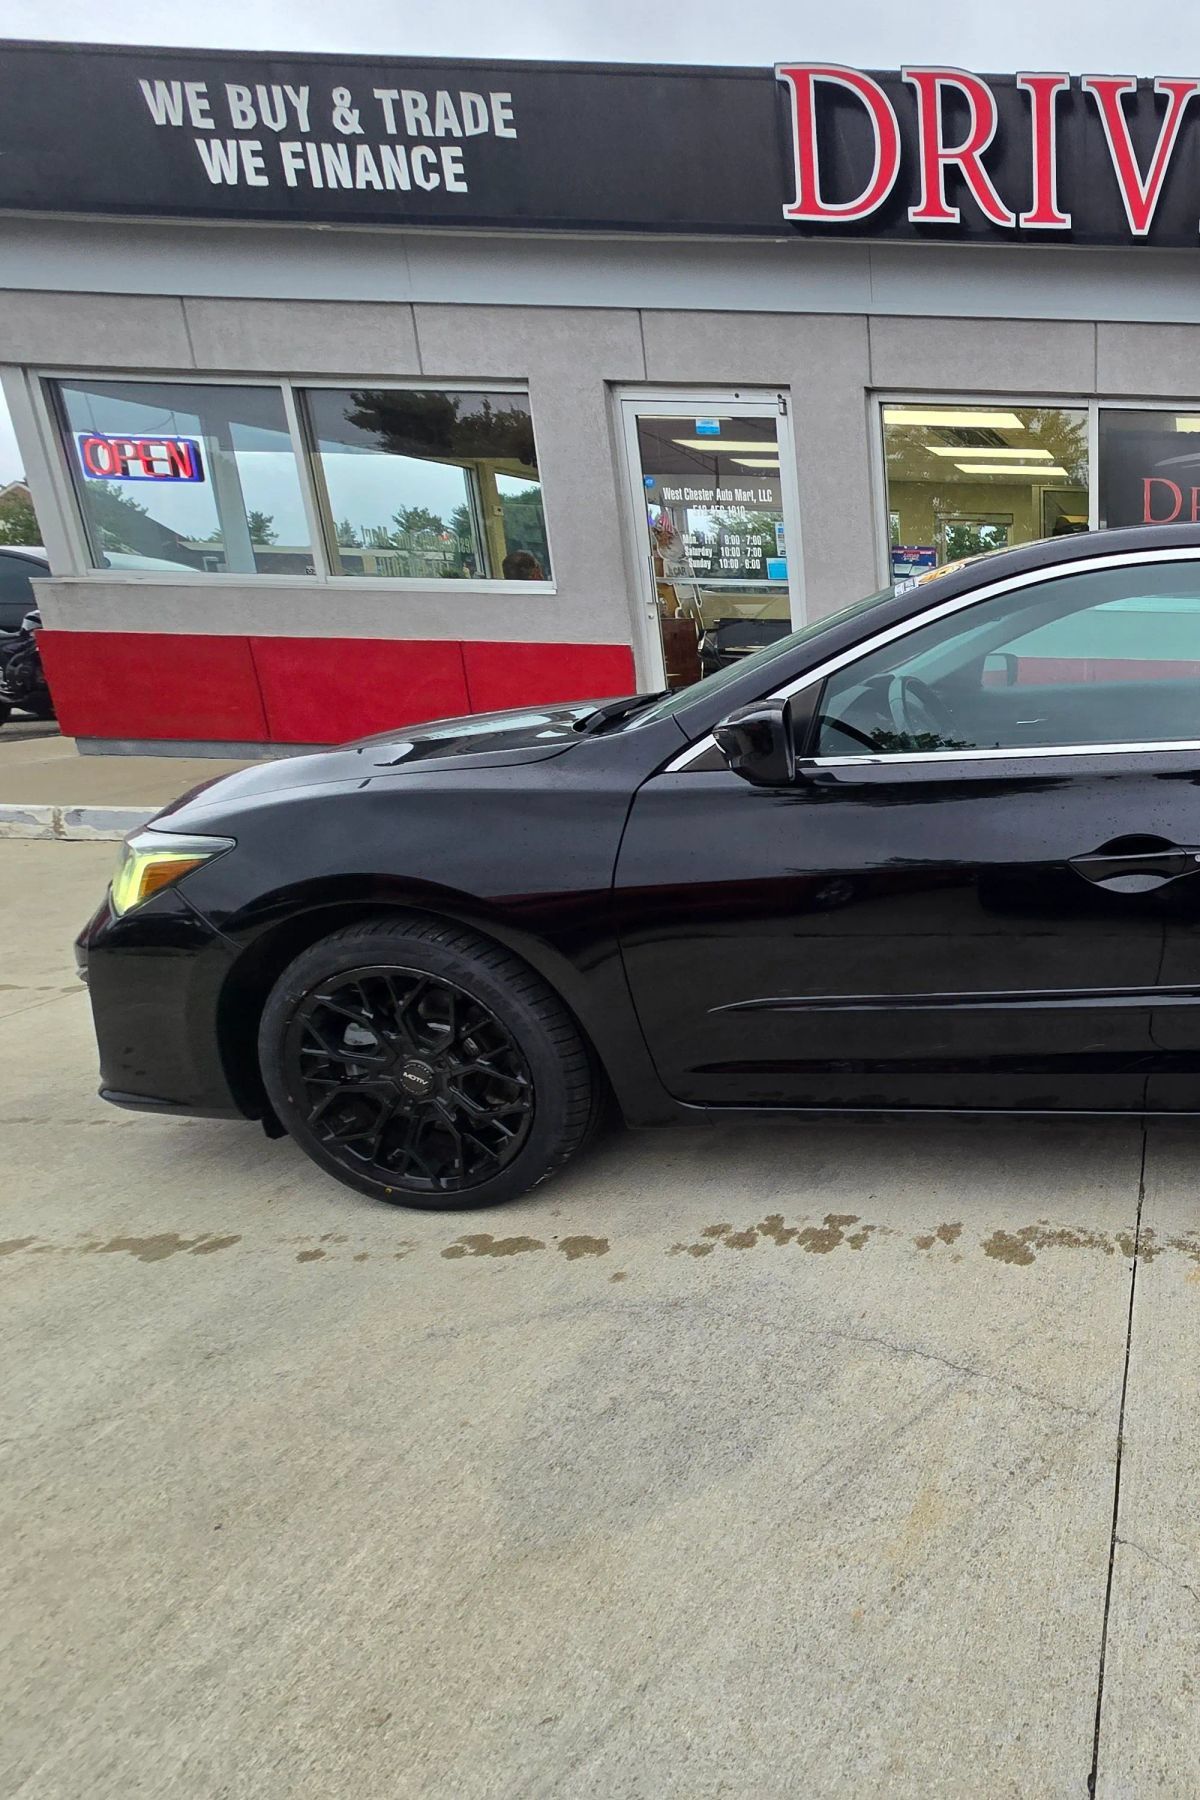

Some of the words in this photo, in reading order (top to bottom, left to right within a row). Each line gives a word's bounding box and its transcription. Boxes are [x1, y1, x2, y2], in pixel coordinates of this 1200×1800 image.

[138, 79, 215, 130] WE
[224, 83, 310, 133] BUY
[332, 87, 365, 135] &
[373, 89, 518, 139] TRADE
[195, 138, 269, 187] WE
[279, 141, 468, 193] FINANCE
[84, 438, 194, 478] OPEN
[663, 487, 682, 501] West
[684, 488, 714, 503] Chester
[716, 488, 733, 502] Auto
[734, 488, 757, 504] Mart,
[758, 489, 773, 503] LLC
[684, 545, 713, 558] Saturday
[720, 546, 741, 557] 10:00
[688, 557, 712, 570] Sunday
[719, 559, 739, 569] 10:00
